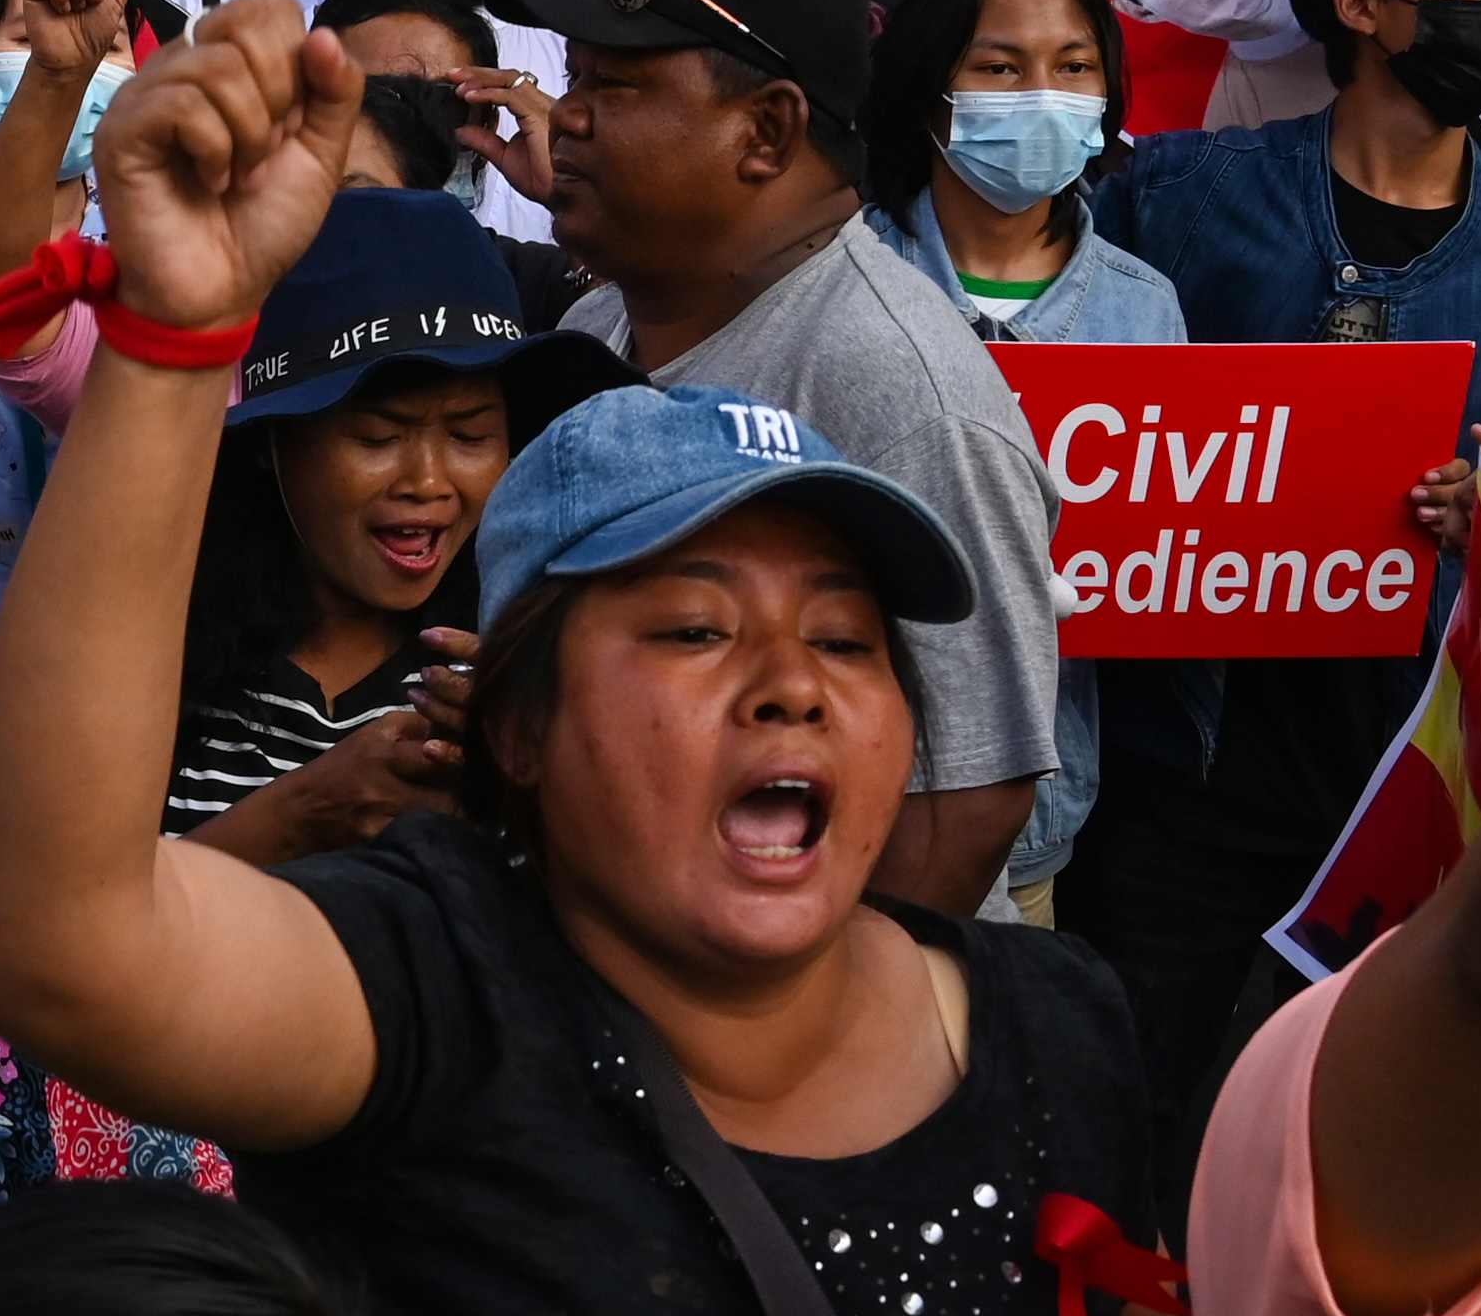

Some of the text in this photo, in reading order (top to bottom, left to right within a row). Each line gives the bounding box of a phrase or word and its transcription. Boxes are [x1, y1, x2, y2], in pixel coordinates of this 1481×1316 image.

[245, 351, 290, 391] TRUE
[717, 402, 800, 453] TRI
[1047, 401, 1292, 505] Civil
[1060, 528, 1416, 615] edience
